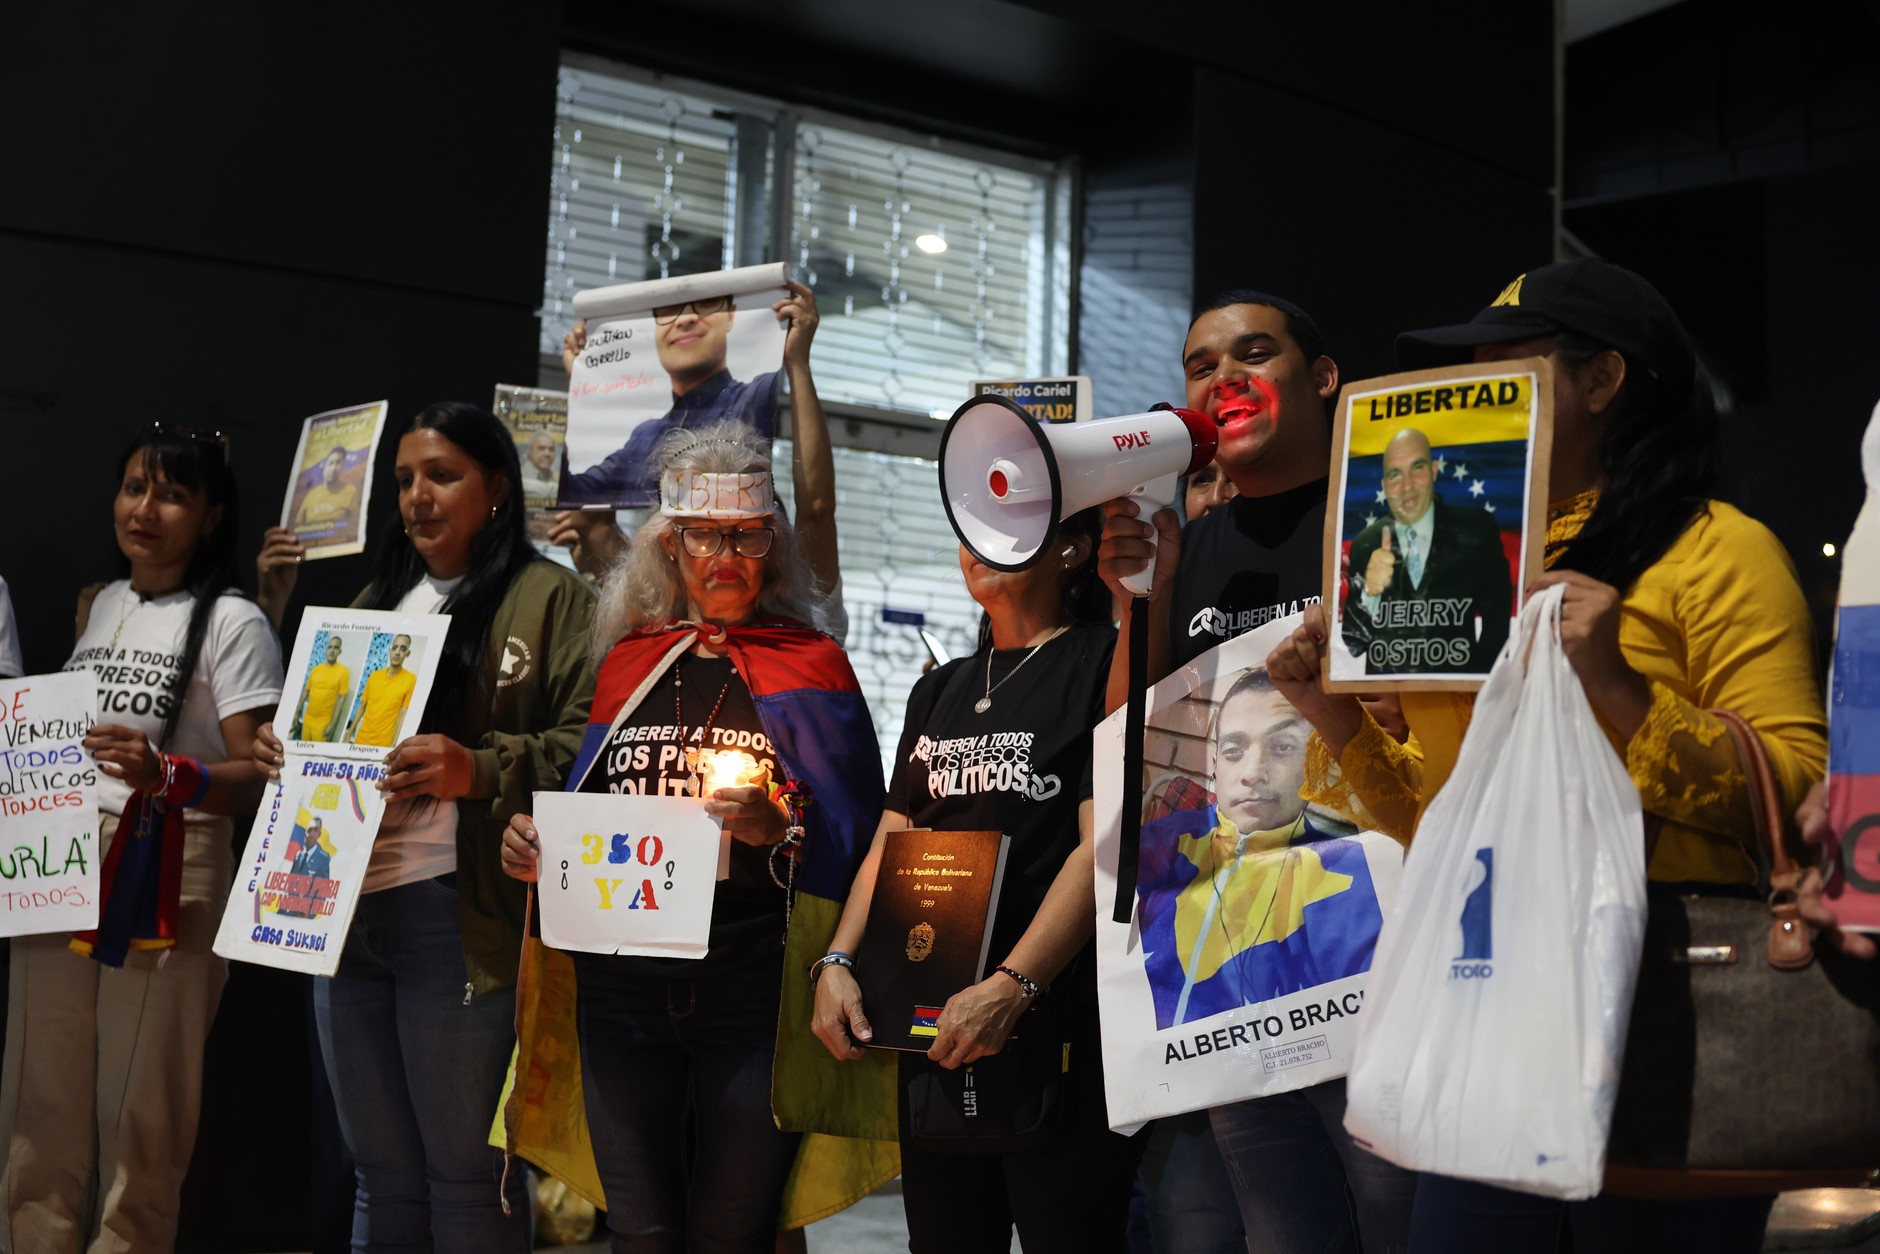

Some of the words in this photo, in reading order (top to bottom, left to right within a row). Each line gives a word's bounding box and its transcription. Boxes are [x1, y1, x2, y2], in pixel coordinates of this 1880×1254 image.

[981, 384, 1031, 397] Ricardo
[1033, 383, 1071, 397] Cariel
[1369, 381, 1520, 422] LIBERTAD
[1112, 430, 1151, 452] PYLE
[1289, 600, 1298, 616] A
[1372, 598, 1473, 628] JERRY
[321, 621, 350, 631] Ricardo
[116, 650, 126, 661] A
[1368, 637, 1471, 667] OSTOS
[612, 726, 688, 746] LIBEREN
[690, 726, 705, 742] A
[711, 727, 776, 755] TODOS
[931, 736, 980, 756] LIBEREN
[977, 734, 988, 749] A
[990, 732, 1035, 748] TODOS
[0, 745, 83, 773] TODOS
[607, 745, 651, 777] LOS
[929, 752, 961, 774] LOS
[961, 746, 1031, 769] PRESOS
[928, 761, 1030, 799] POLÍTICOS
[912, 867, 940, 877] República
[941, 867, 973, 877] Bolivariana
[913, 882, 922, 891] de
[923, 883, 953, 892] Venezuela
[920, 899, 935, 908] 1999
[1164, 1015, 1284, 1065] ALBERTO
[1288, 989, 1365, 1031] BRAC
[1263, 1046, 1296, 1061] ALBERTO
[1296, 1039, 1326, 1053] BRACHO
